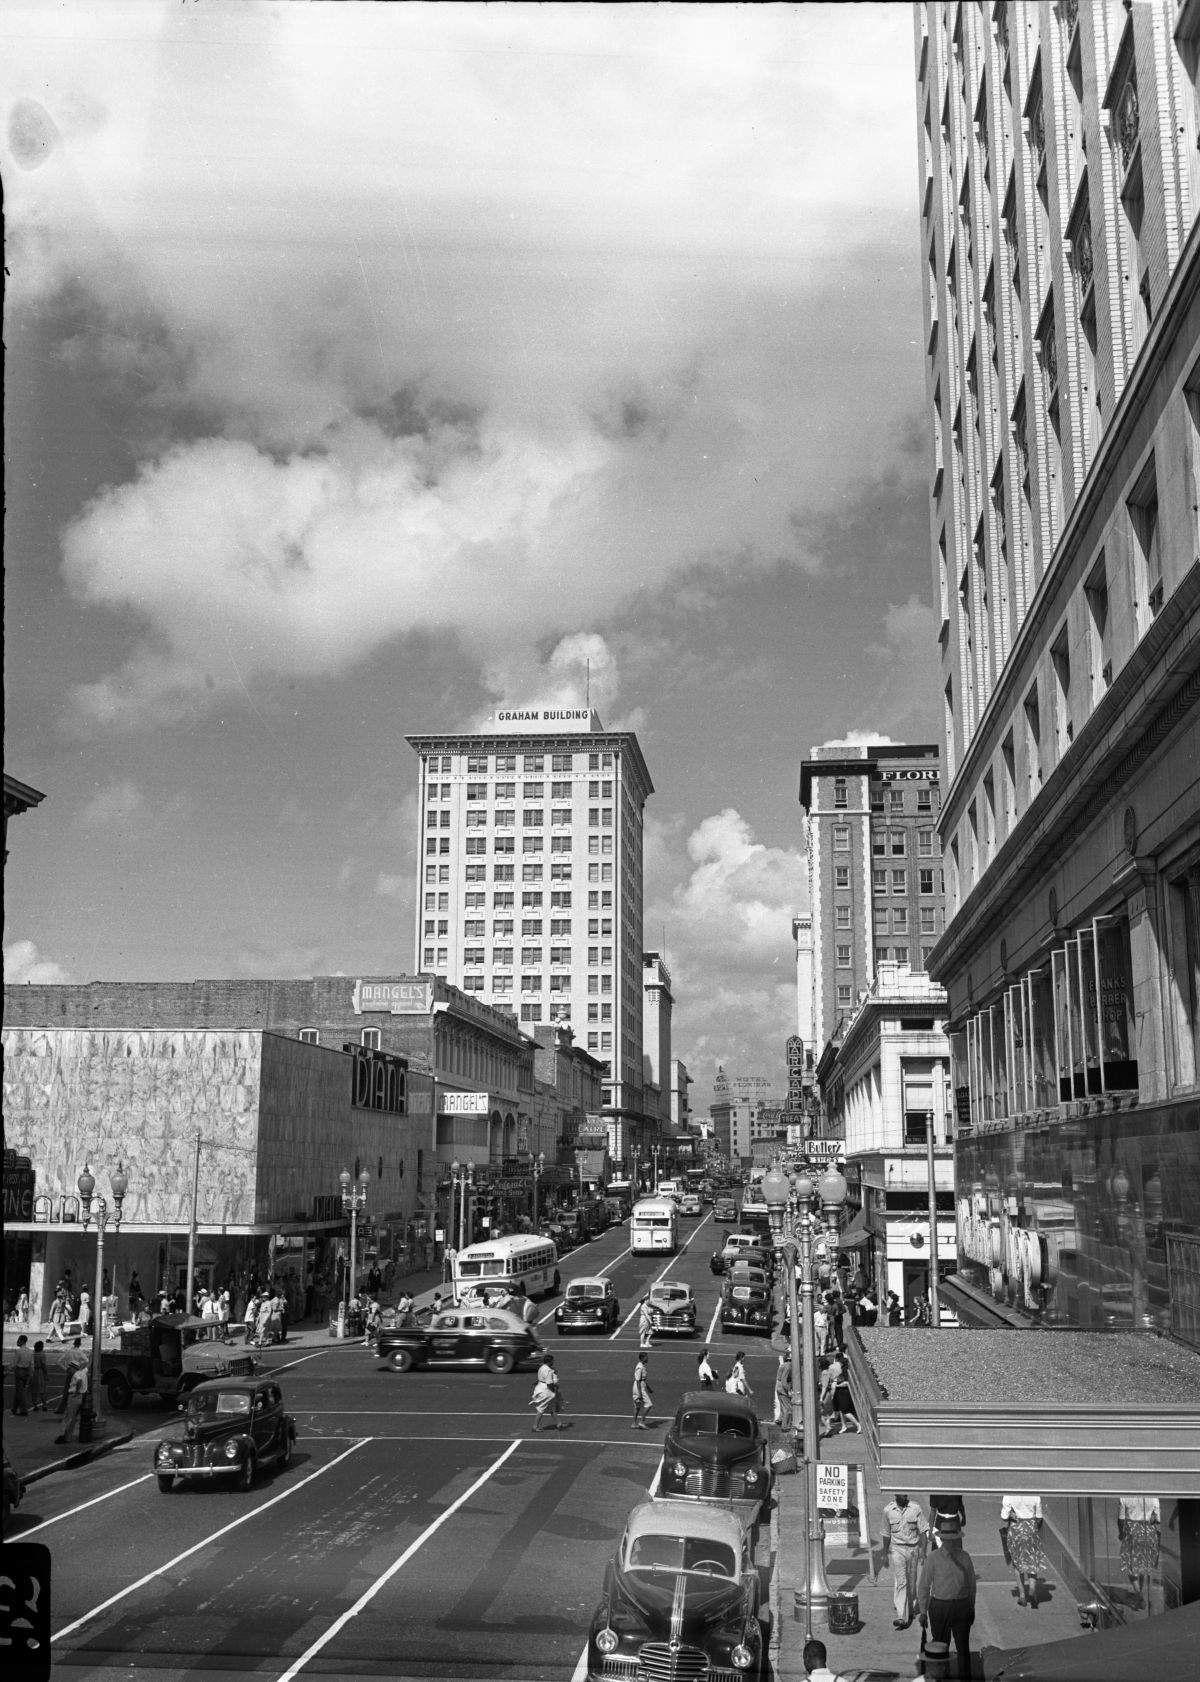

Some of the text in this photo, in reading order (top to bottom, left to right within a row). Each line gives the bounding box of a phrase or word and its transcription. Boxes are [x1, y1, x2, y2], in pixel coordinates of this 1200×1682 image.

[498, 710, 588, 720] GRAHAM BUILDING
[362, 985, 424, 999] MANGEL'S
[1090, 992, 1127, 1008] BRBER
[356, 1055, 407, 1114] DIANA
[790, 1046, 801, 1110] ARCADE
[439, 1095, 487, 1111] MANGEL'S
[825, 1466, 840, 1478] NO
[819, 1478, 846, 1487] PARKING
[819, 1488, 846, 1496] SAFETY
